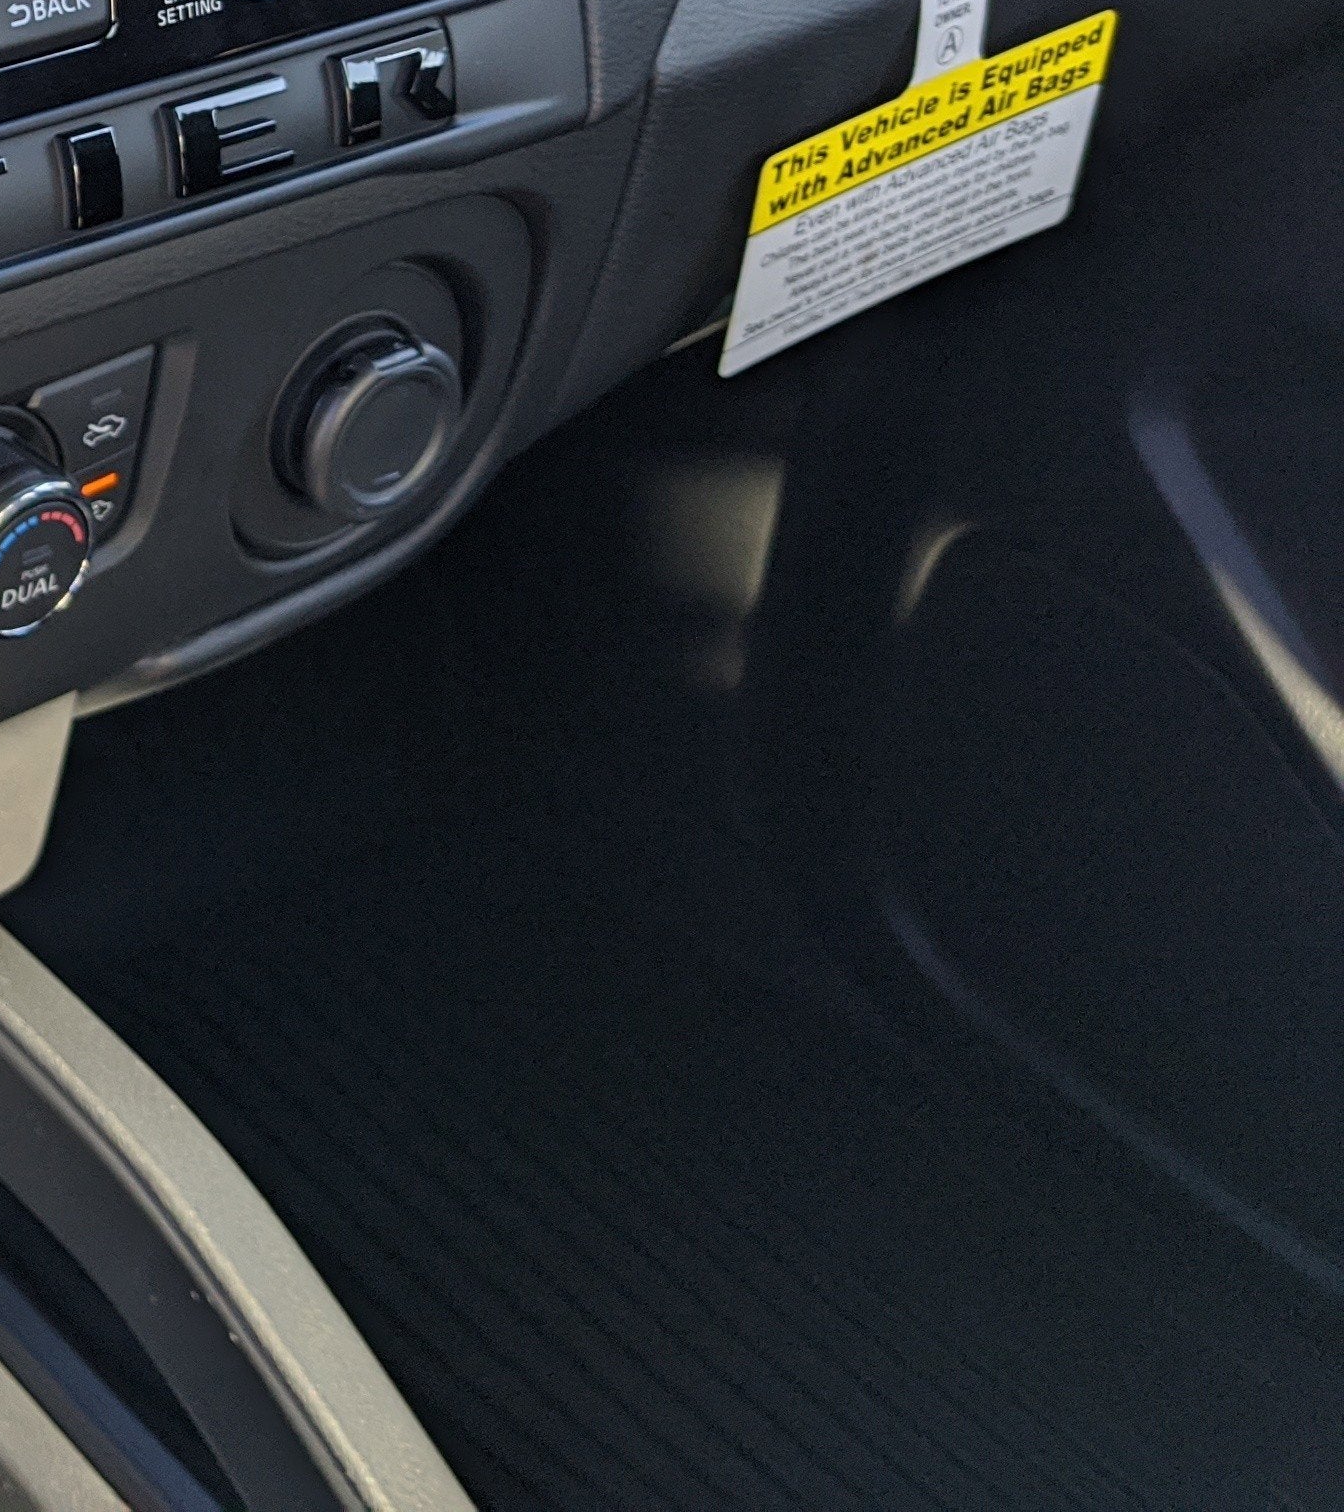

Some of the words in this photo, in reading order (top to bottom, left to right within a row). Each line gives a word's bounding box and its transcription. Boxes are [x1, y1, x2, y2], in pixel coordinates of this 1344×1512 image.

[768, 173, 828, 216] with
[835, 103, 972, 185] Advanced
[977, 88, 1019, 122] Air
[1025, 59, 1093, 102] Bags
[773, 143, 830, 185] This
[840, 96, 940, 152] Vehicle
[948, 80, 972, 105] is
[981, 19, 1106, 91] Equipped
[0, 572, 59, 609] DUAL
